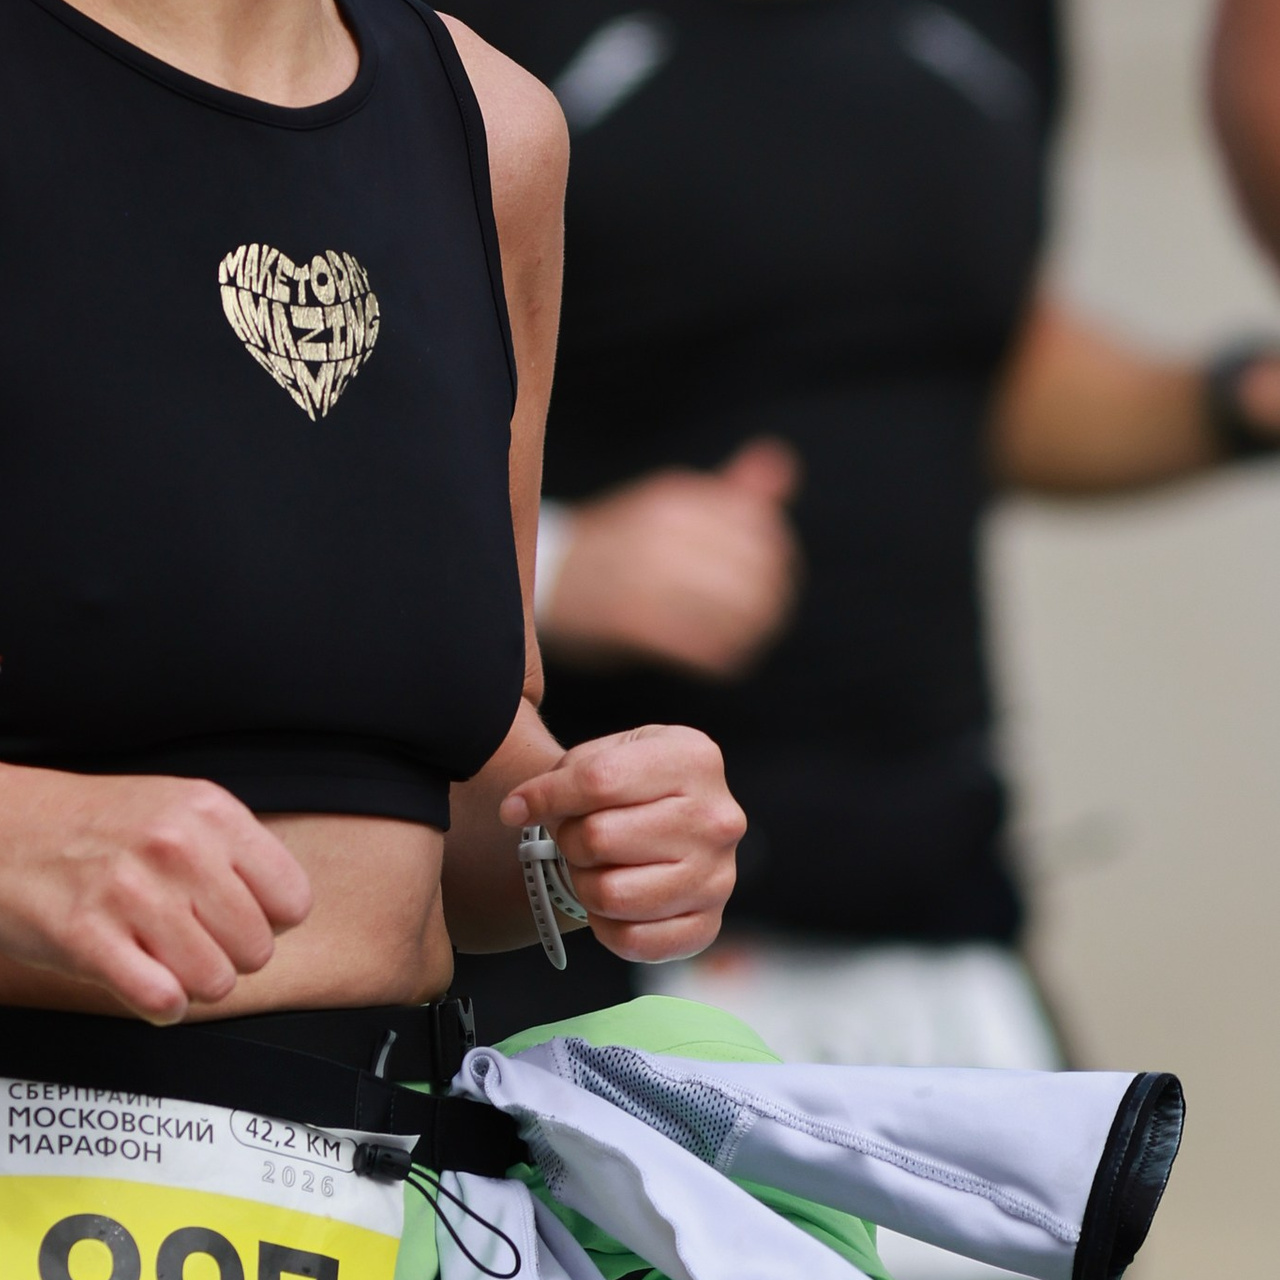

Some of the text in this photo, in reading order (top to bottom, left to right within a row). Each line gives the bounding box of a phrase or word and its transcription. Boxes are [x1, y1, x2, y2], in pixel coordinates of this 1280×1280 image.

[218, 243, 295, 304] MAKE
[220, 291, 380, 361] AMAZING
[8, 1105, 215, 1144] МОСКОВСКИЙ
[245, 1117, 342, 1162] 42,2 КМ
[8, 1133, 163, 1163] МАРАФОН
[261, 1160, 335, 1197] 2026
